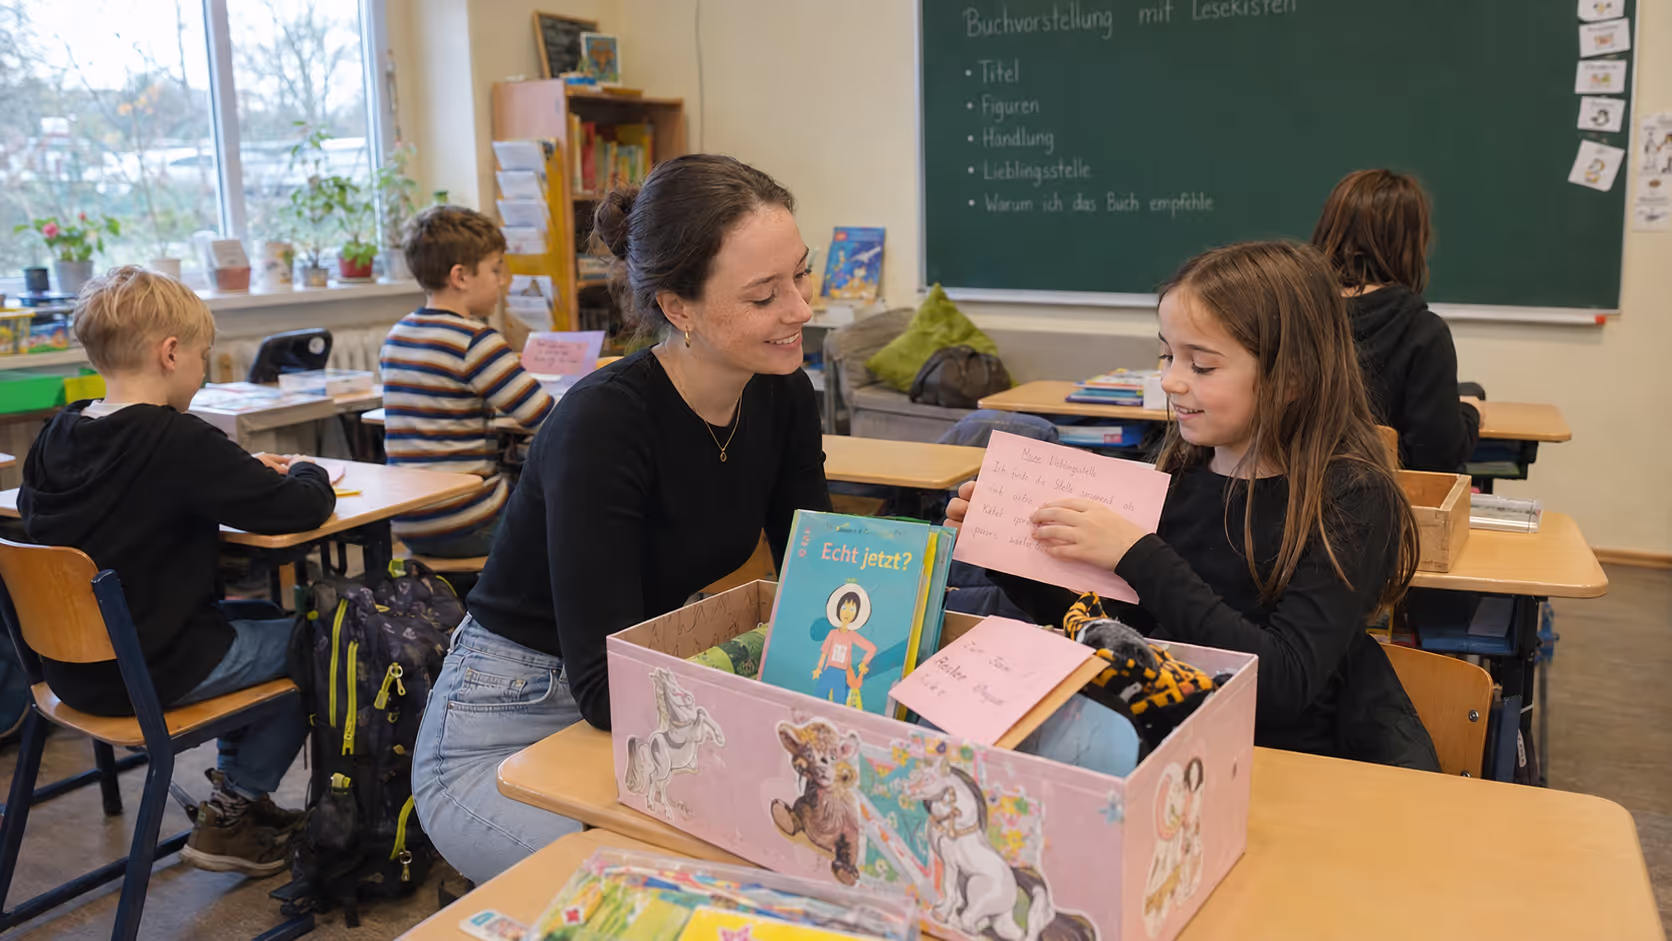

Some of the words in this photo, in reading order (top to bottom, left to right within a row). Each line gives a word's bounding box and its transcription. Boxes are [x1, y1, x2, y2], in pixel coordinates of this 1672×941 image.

[962, 3, 1113, 39] Buchvorstellung
[1138, 0, 1175, 24] mit
[1192, 0, 1296, 20] Lesekisten
[978, 57, 1020, 83] Titel
[981, 93, 1040, 122] Figuren
[983, 125, 1055, 155] Handlung
[983, 156, 1091, 187] Lieblingsstelle
[985, 193, 1033, 213] Warum
[1042, 192, 1063, 212] ich
[1072, 192, 1097, 212] das
[1107, 191, 1139, 212] Buch
[1149, 191, 1215, 218] empfehle
[991, 460, 1007, 474] Ich
[1053, 478, 1073, 494] Stelle
[821, 541, 859, 564] Echt
[859, 547, 913, 571] jetzt?
